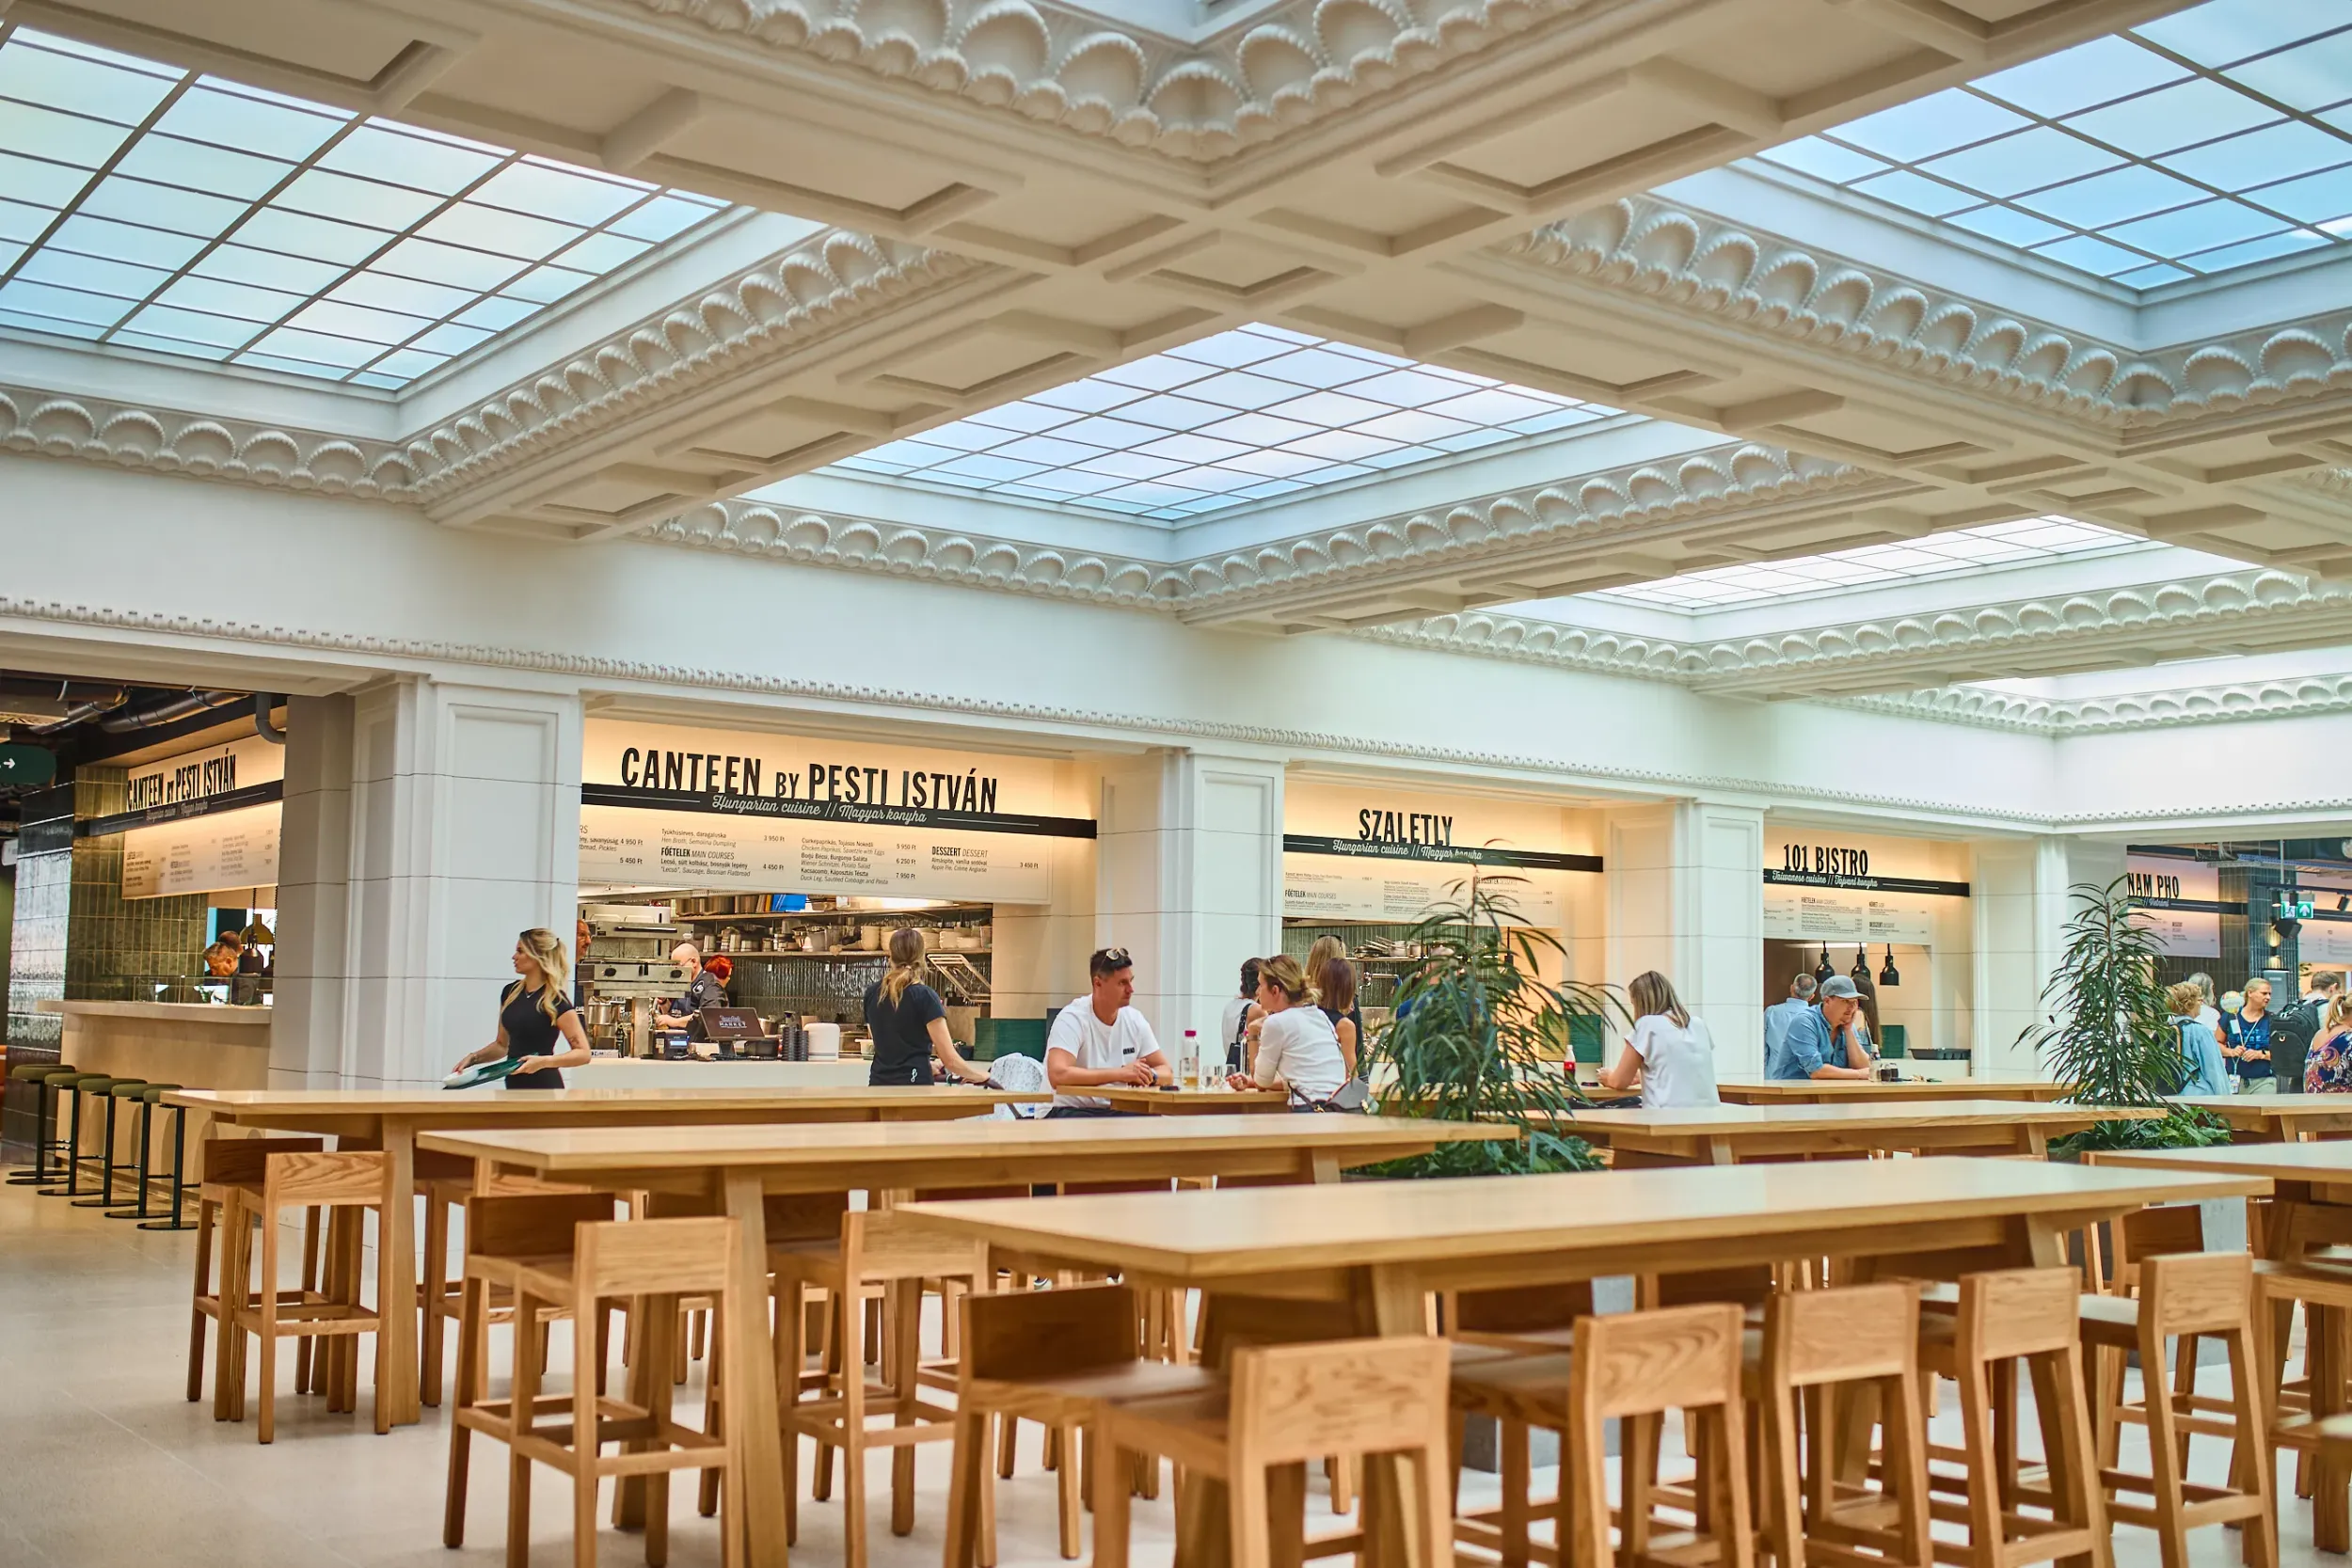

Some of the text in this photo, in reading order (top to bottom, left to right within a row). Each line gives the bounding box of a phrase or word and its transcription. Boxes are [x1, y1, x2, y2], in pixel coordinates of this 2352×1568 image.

[127, 748, 236, 811] CANTEEN BY PESTI ISTVÁN
[622, 747, 997, 814] CANTEEN BY PESTI ISTVÁN
[712, 795, 779, 815] Hungarian
[781, 801, 821, 816] cuisine
[839, 804, 885, 822] Magyar
[885, 808, 928, 825] konyha
[1359, 808, 1453, 847] SZALETLY
[661, 847, 691, 857] FŐÉTELEK
[707, 851, 735, 861] COURSES
[931, 847, 988, 858] DESSZERT DESSERT
[1332, 840, 1379, 855] Hungarian
[1380, 845, 1408, 855] cuisine
[1421, 846, 1454, 861] Magyar
[1784, 844, 1867, 876] 101 BISTRO
[1772, 870, 1805, 882] Taiwanese
[1805, 875, 1826, 884] cuisine
[1835, 875, 1856, 888] Tajvani
[1857, 878, 1879, 889] konyha
[2127, 873, 2180, 898] NAM PHO
